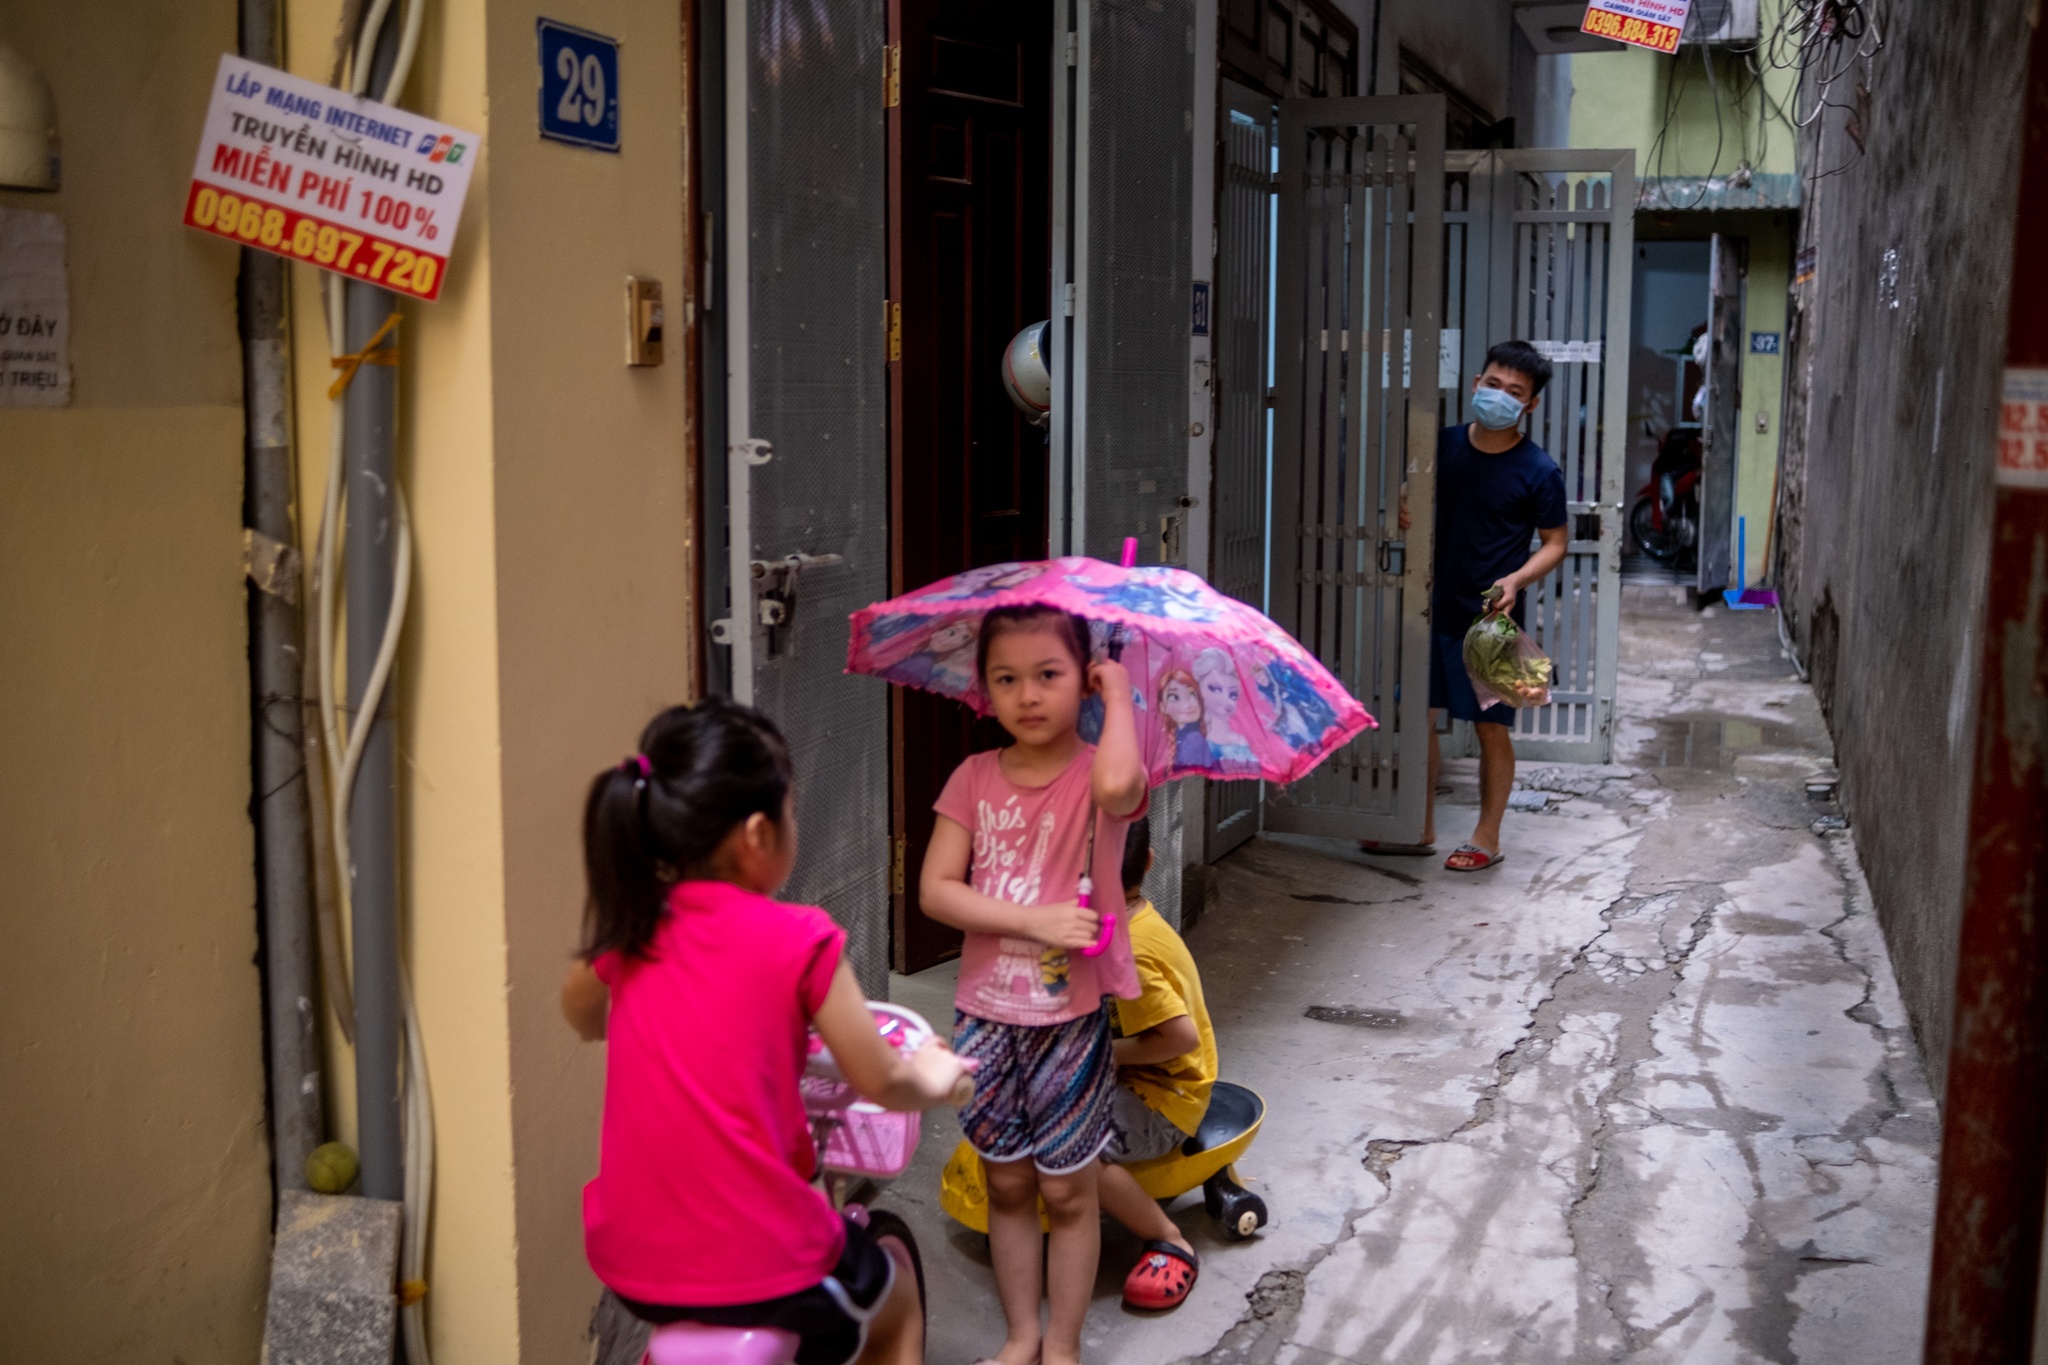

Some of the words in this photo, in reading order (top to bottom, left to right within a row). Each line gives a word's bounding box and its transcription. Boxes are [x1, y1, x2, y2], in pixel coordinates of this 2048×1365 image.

[1603, 1, 1634, 14] CAMERA
[1669, 6, 1686, 17] HD
[1585, 9, 1679, 50] 0396.884.313
[556, 46, 605, 127] 29
[226, 71, 262, 100] LẮP
[265, 86, 322, 120] MẠNG
[325, 105, 413, 149] INTERNET
[417, 133, 467, 164] FPT
[231, 112, 328, 160] TRUYỀN
[334, 143, 401, 183] HÌNH
[406, 168, 444, 196] HD
[212, 143, 294, 194] MIỄN
[298, 171, 353, 213] PHÍ
[361, 190, 438, 241] 100%
[193, 188, 437, 294] 0968.697.720
[16, 314, 58, 338] ĐÂY
[1755, 334, 1775, 351] 37
[10, 370, 59, 391] TRIỆU
